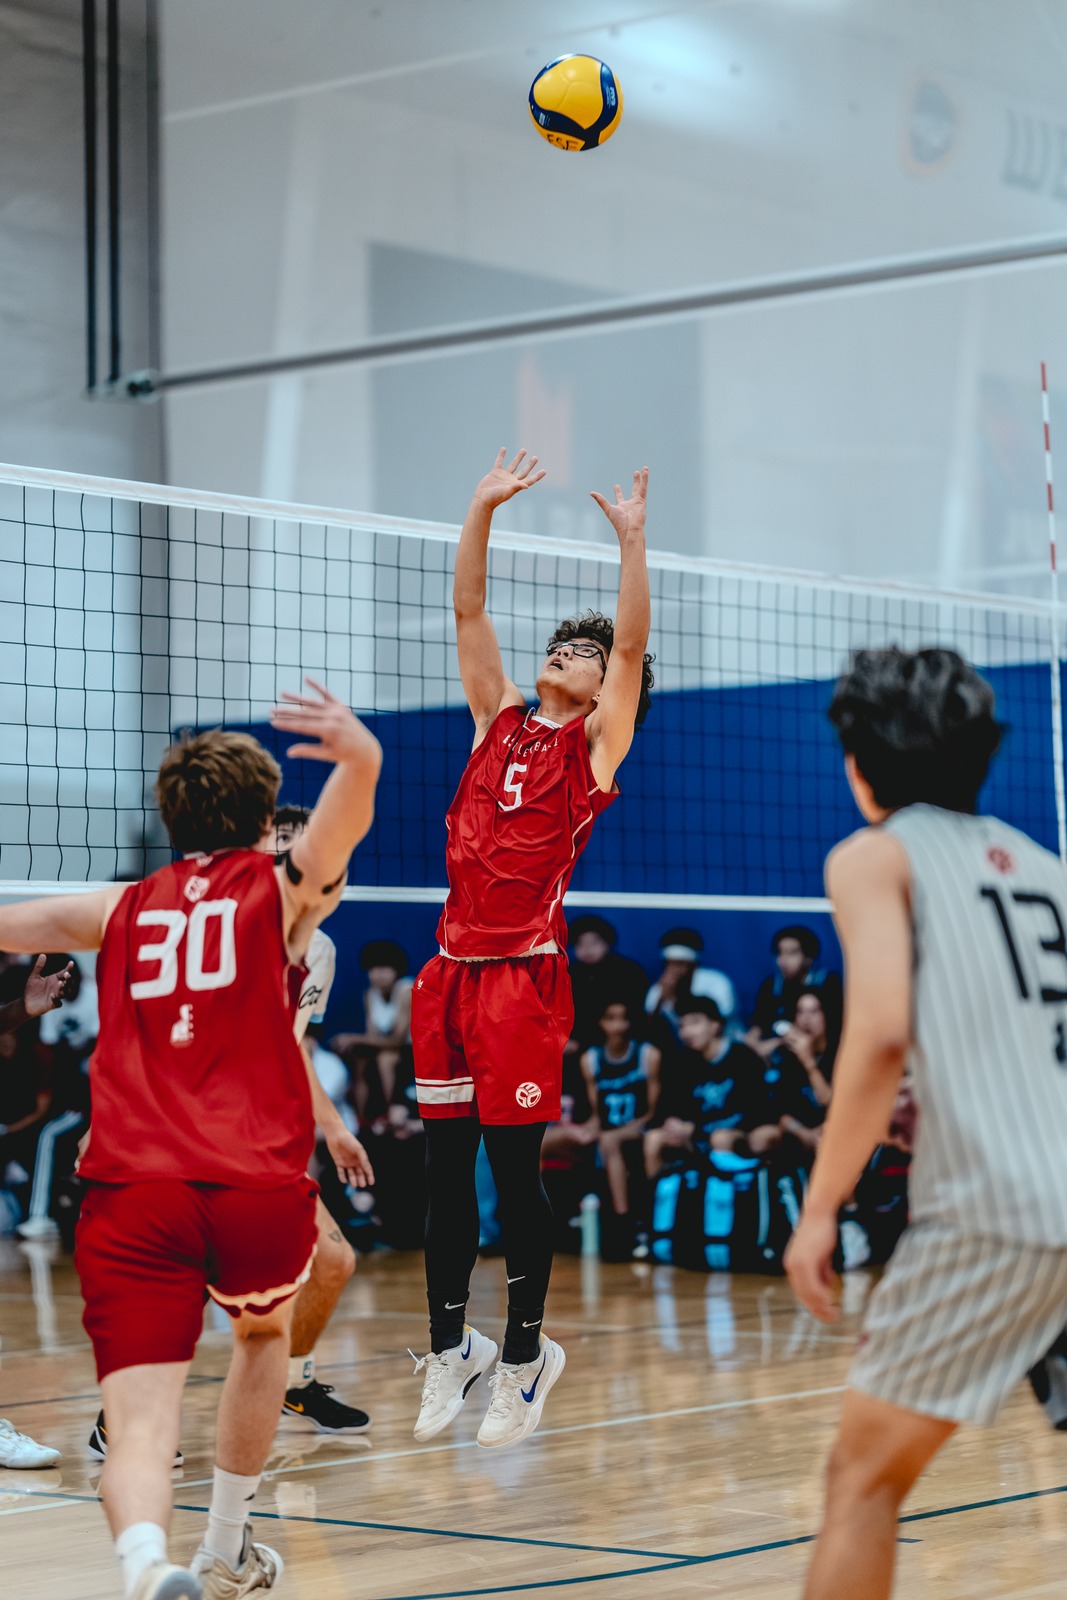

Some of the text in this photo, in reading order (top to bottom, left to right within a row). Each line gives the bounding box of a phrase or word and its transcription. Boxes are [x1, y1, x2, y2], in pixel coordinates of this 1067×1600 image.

[498, 762, 527, 812] 5
[130, 897, 238, 1000] 30
[979, 886, 1067, 1004] 13
